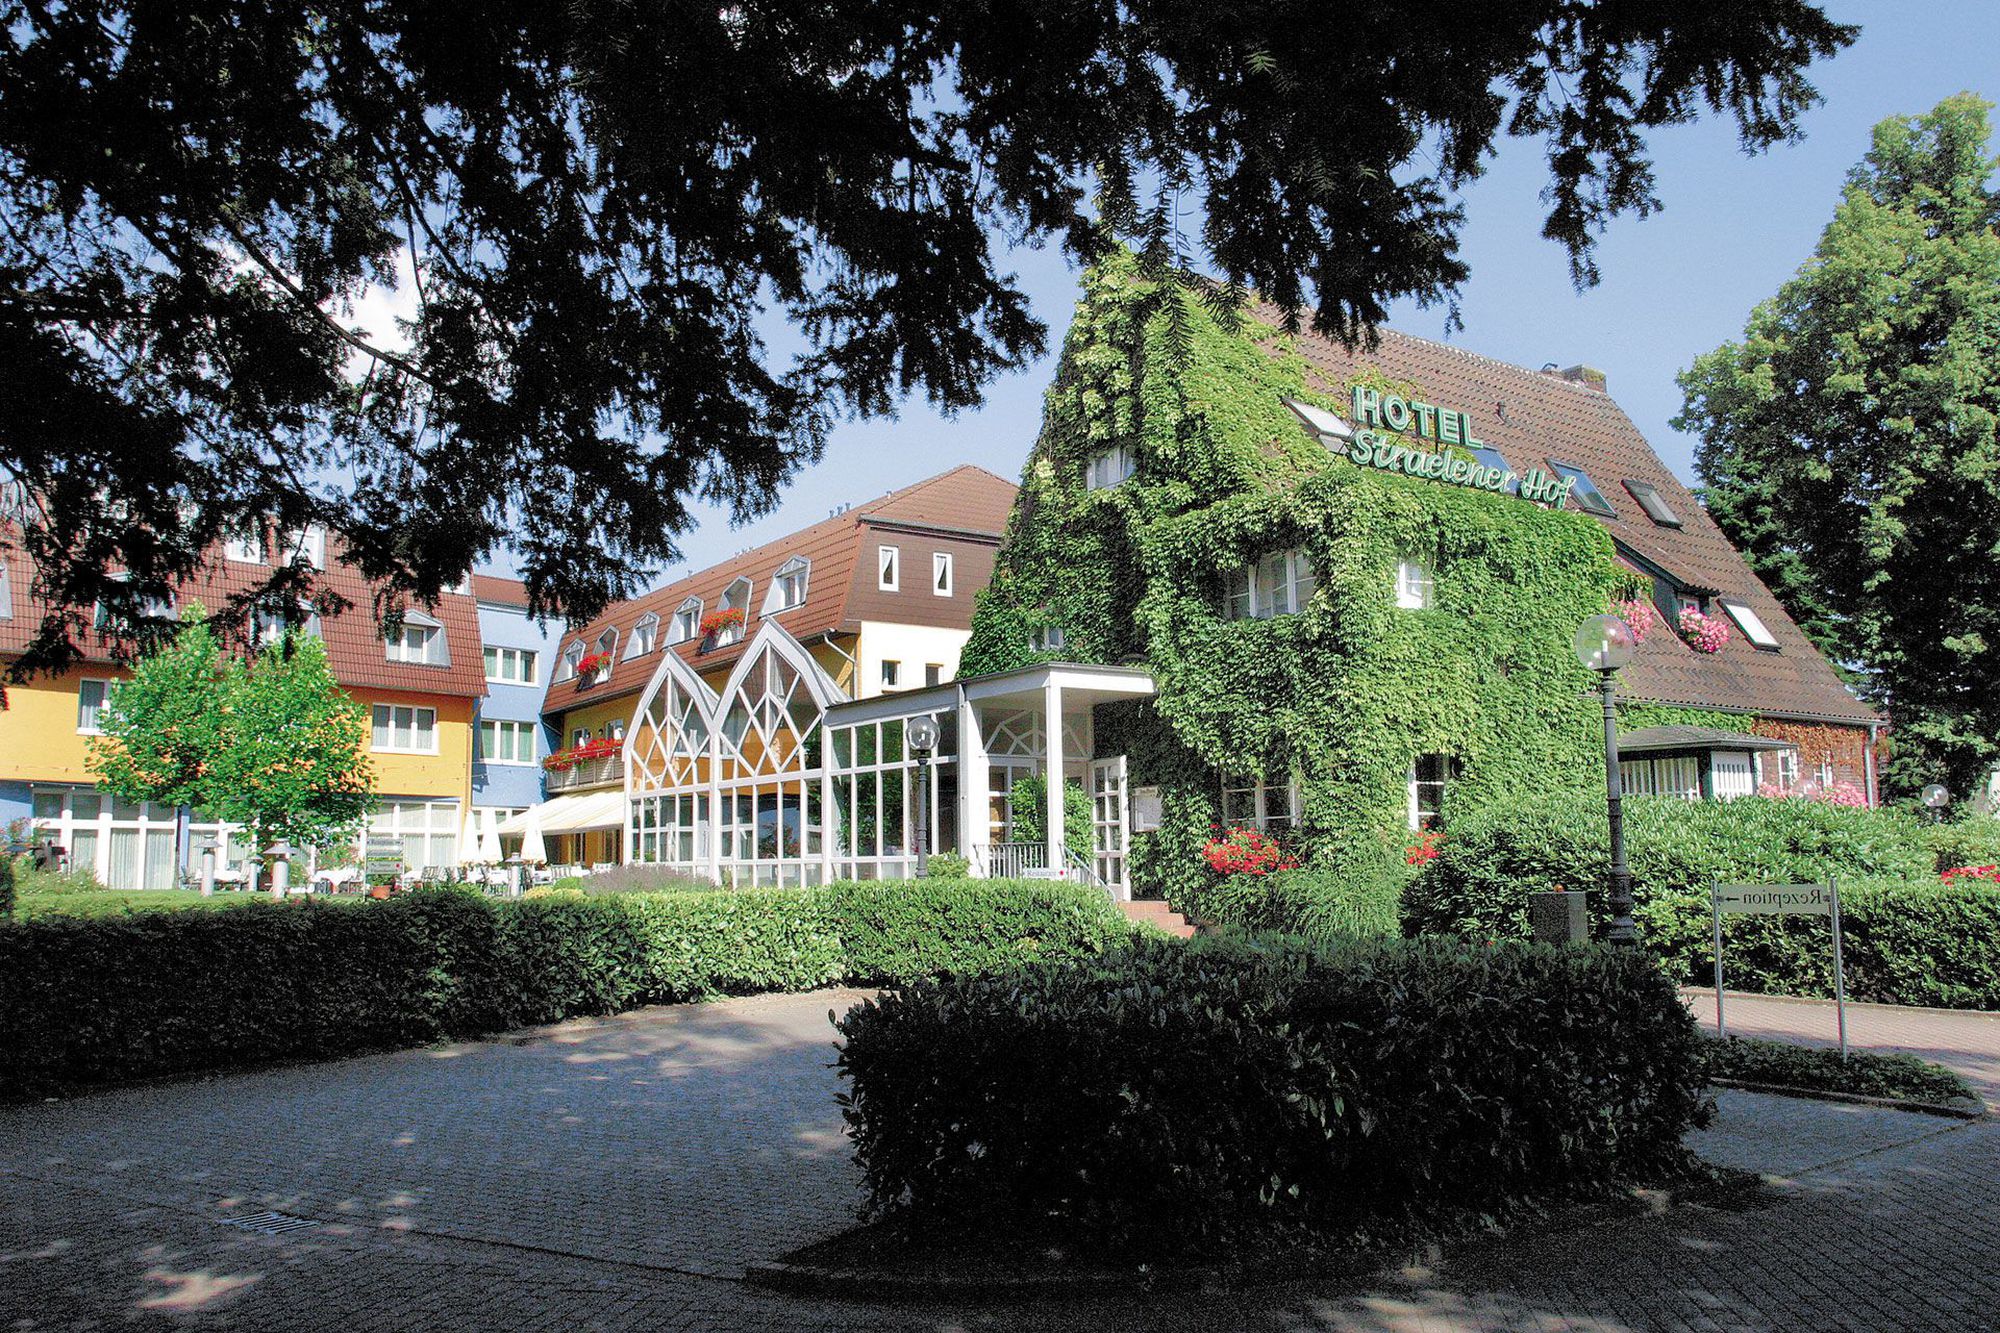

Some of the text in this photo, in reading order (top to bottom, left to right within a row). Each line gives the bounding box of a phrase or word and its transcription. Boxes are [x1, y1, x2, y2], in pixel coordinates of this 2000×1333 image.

[1351, 386, 1483, 449] HOTEL
[1350, 428, 1577, 509] Straelener Hof
